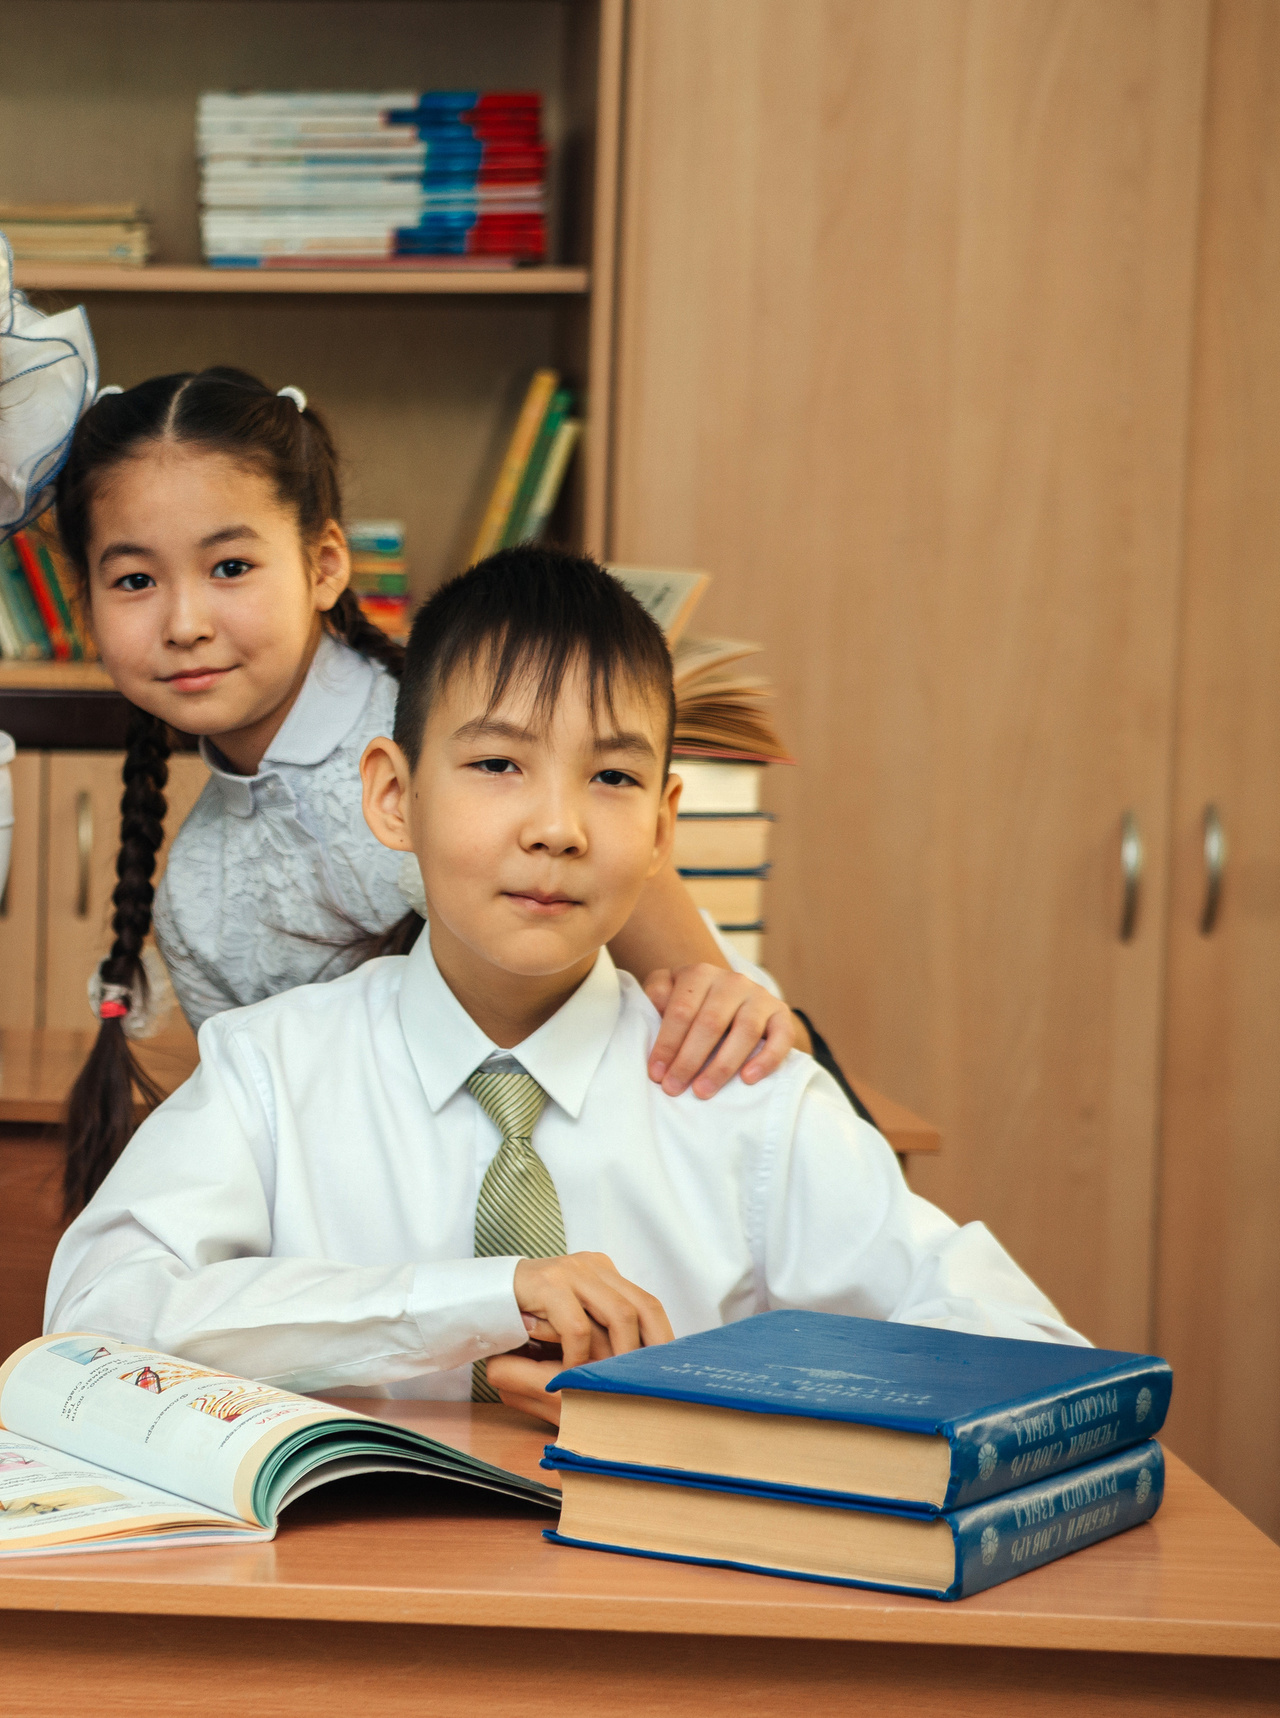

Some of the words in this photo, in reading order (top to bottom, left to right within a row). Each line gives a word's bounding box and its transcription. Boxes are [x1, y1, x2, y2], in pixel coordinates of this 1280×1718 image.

[659, 1366, 780, 1387] СЛОВАРЬ
[680, 1362, 770, 1381] ЯЗЫКА
[791, 1379, 933, 1400] РУССКОГО
[66, 1402, 86, 1420] Так
[71, 1395, 85, 1422] почти
[795, 1385, 931, 1405] УЧЕБНЫЙ
[1061, 1388, 1118, 1431] РУССКОГО
[145, 1393, 189, 1444] Фломастеры
[1013, 1407, 1056, 1447] ЯЗЫКА
[1067, 1420, 1120, 1459] УЧЕБНЫЙ
[1010, 1440, 1063, 1479] СЛОВАРЬ
[1012, 1492, 1055, 1529] ЯЗЫКА
[1061, 1472, 1118, 1512] РУССКОГО
[1065, 1501, 1119, 1543] УЧЕБНЫЙ
[1010, 1523, 1062, 1563] СЛОВАРЬ
